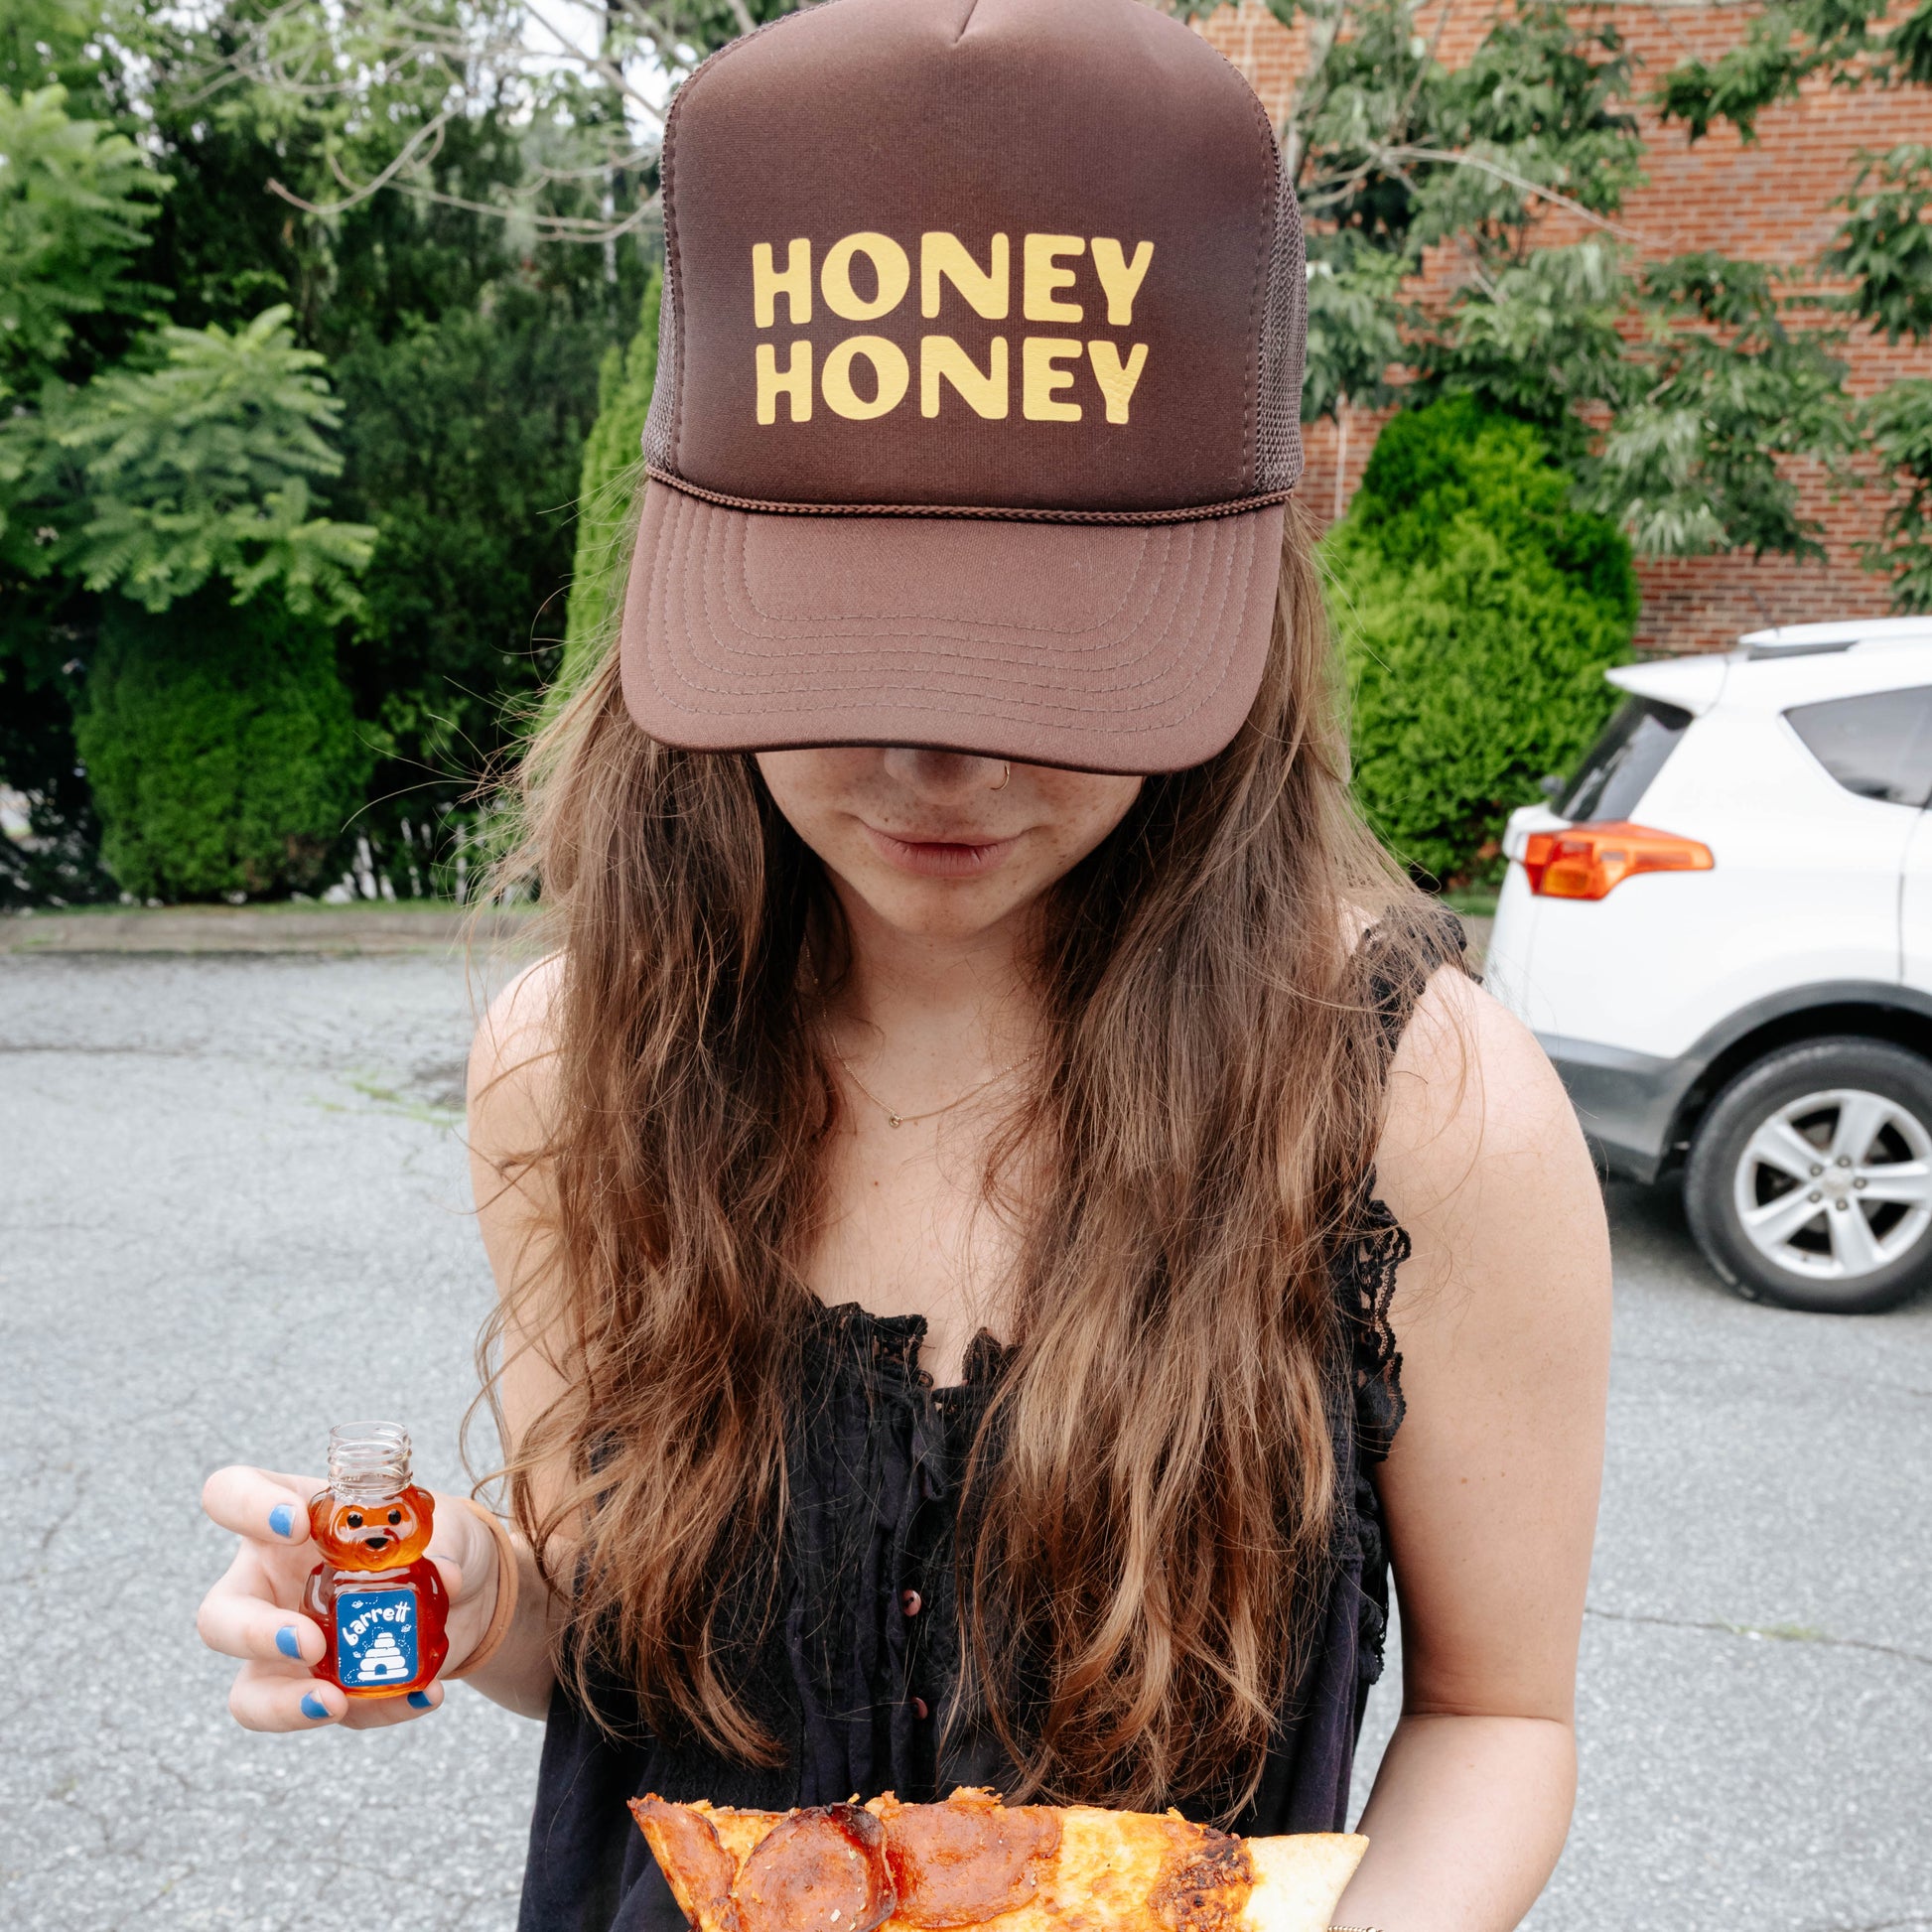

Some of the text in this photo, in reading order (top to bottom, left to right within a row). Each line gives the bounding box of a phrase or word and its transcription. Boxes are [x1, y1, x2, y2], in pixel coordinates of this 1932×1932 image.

[752, 231, 1155, 328] HONEY
[756, 335, 1149, 425] HONEY
[342, 1600, 411, 1646] barrett
